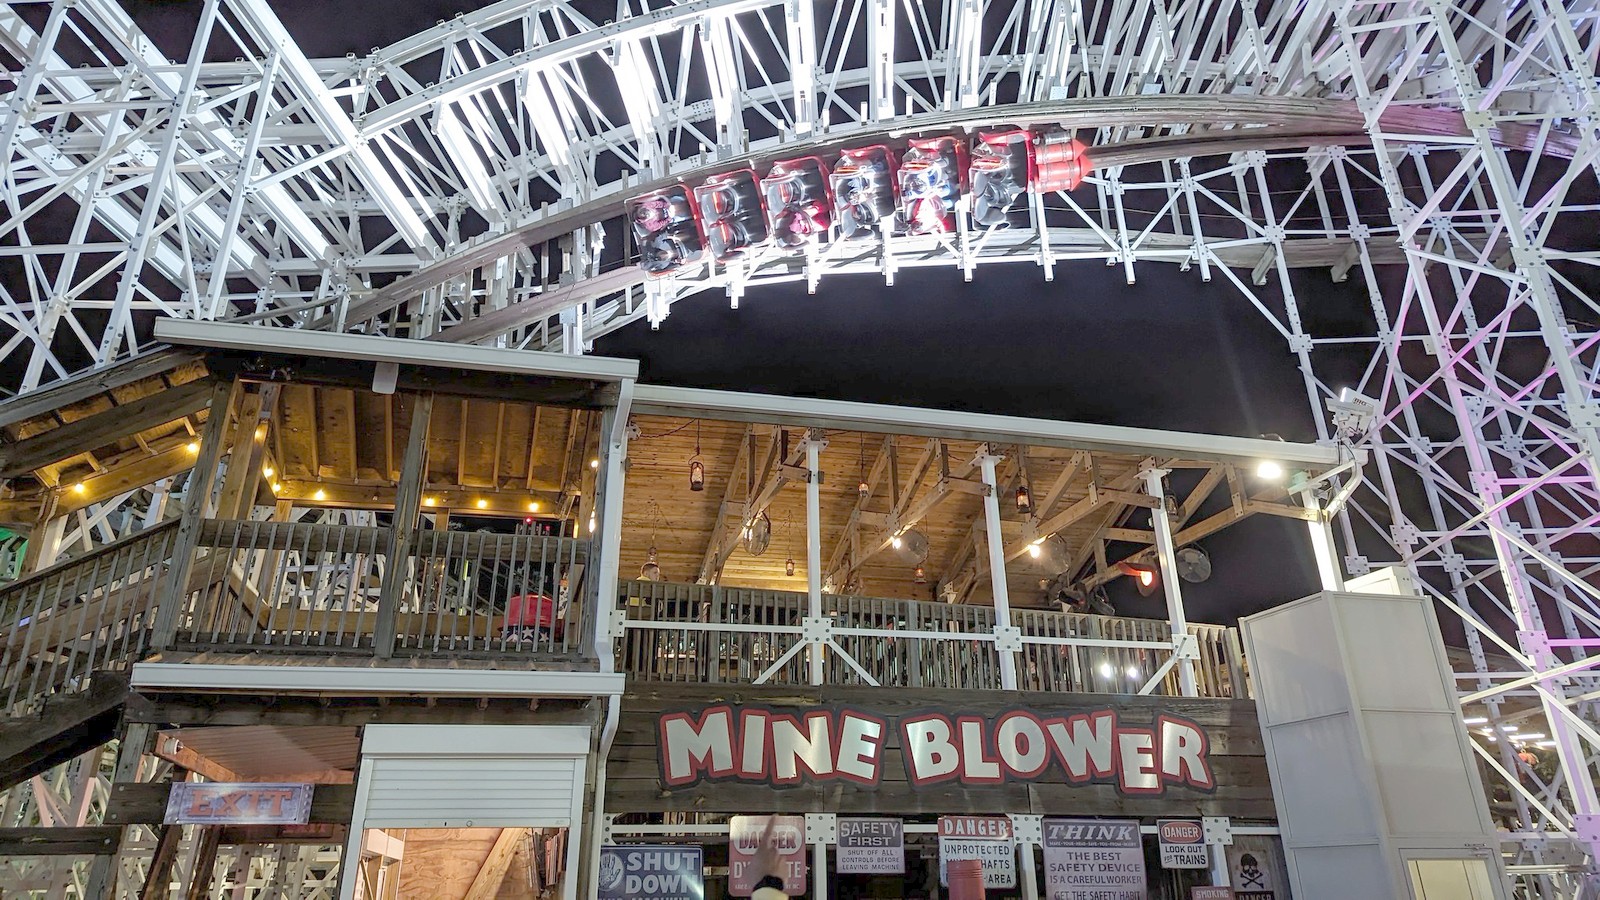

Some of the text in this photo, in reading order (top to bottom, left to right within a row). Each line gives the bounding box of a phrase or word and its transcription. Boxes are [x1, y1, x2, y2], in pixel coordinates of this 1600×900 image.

[662, 709, 1211, 790] MINE BLOWER
[187, 789, 293, 817] EXIT
[840, 821, 899, 837] SAFETY
[944, 819, 1009, 836] DANGER
[1048, 824, 1135, 840] THINK
[1164, 826, 1199, 838] DANGER
[848, 836, 891, 846] FIRST
[944, 845, 1010, 855] UNPROTECTED
[1165, 845, 1185, 853] LOOK
[626, 852, 699, 871] SHUT
[1067, 852, 1122, 861] THE BEST
[1174, 855, 1206, 865] TRAINS
[981, 860, 1010, 869] HAFTS
[1049, 863, 1140, 872] SAFETY DEVICE
[988, 874, 1012, 883] AREA
[1050, 875, 1141, 884] IS A CAREFUL WORKER
[1072, 891, 1086, 900] THE
[1090, 891, 1117, 900] SAFETY
[1196, 890, 1229, 898] SMOKING
